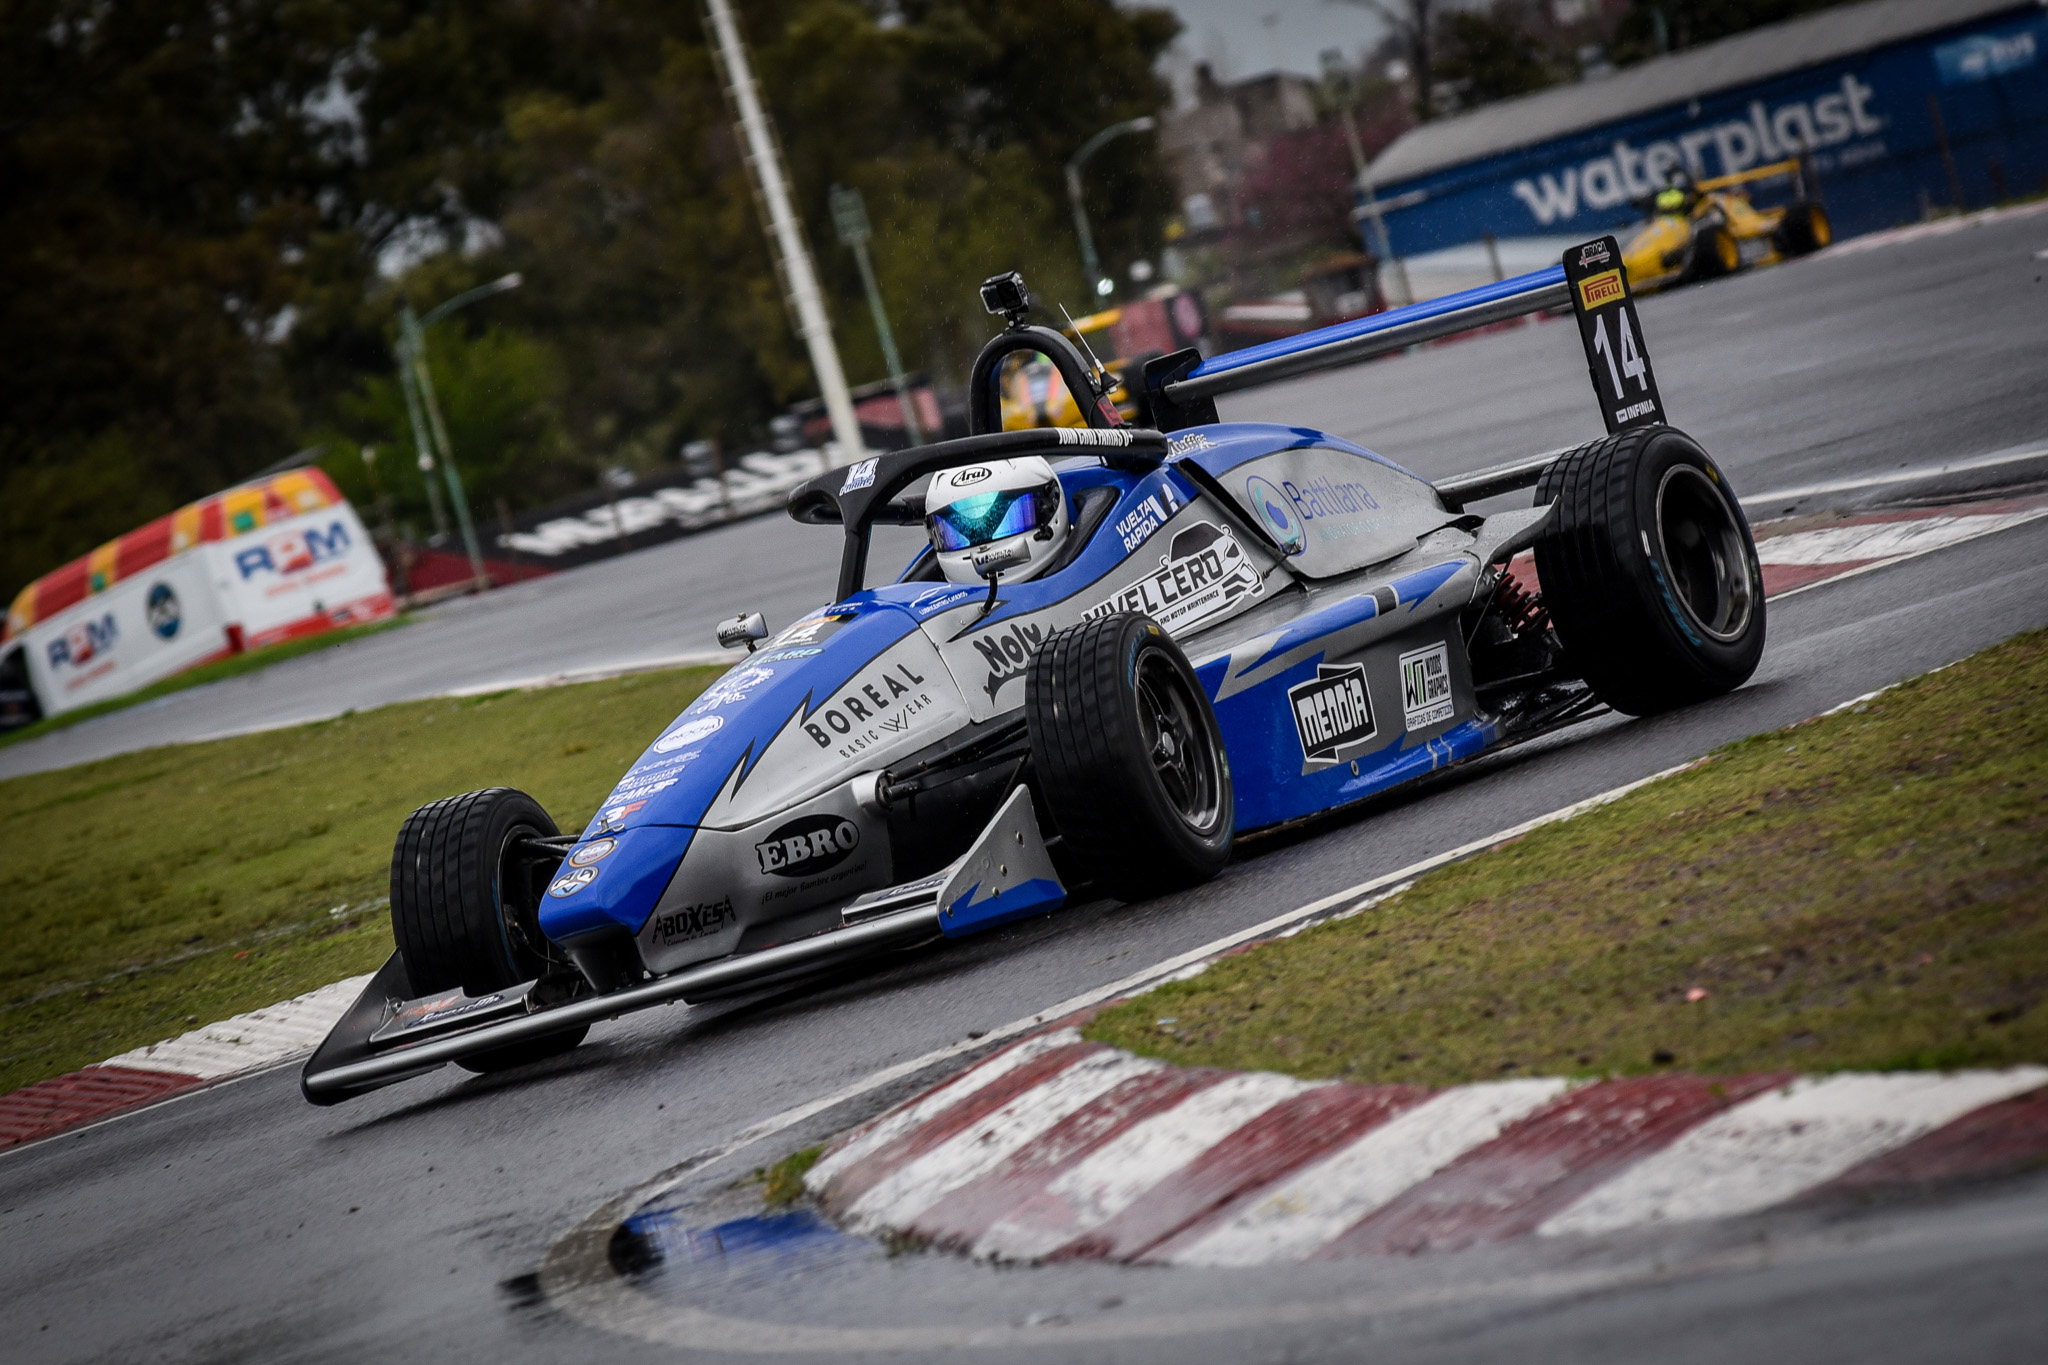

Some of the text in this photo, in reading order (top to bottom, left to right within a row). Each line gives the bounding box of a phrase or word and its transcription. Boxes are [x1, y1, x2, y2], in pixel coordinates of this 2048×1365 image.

[1512, 73, 1880, 225] waterplast
[1583, 274, 1622, 303] PIRELLI
[1594, 306, 1648, 400] 14
[1627, 399, 1656, 420] INFINIA
[846, 458, 879, 485] 14
[953, 467, 987, 486] Arai
[1282, 475, 1381, 520] Battilana
[1115, 499, 1153, 538] VUELTA
[1123, 515, 1159, 554] RAPIDA
[1156, 548, 1224, 606] CERO
[1170, 606, 1187, 620] MOTOR
[1425, 653, 1442, 677] WOODS
[804, 663, 925, 749] BOREAL
[839, 693, 932, 758] BASIC WEAR
[756, 819, 861, 875] EBRO
[775, 885, 798, 899] mejor
[800, 875, 830, 893] fiambre
